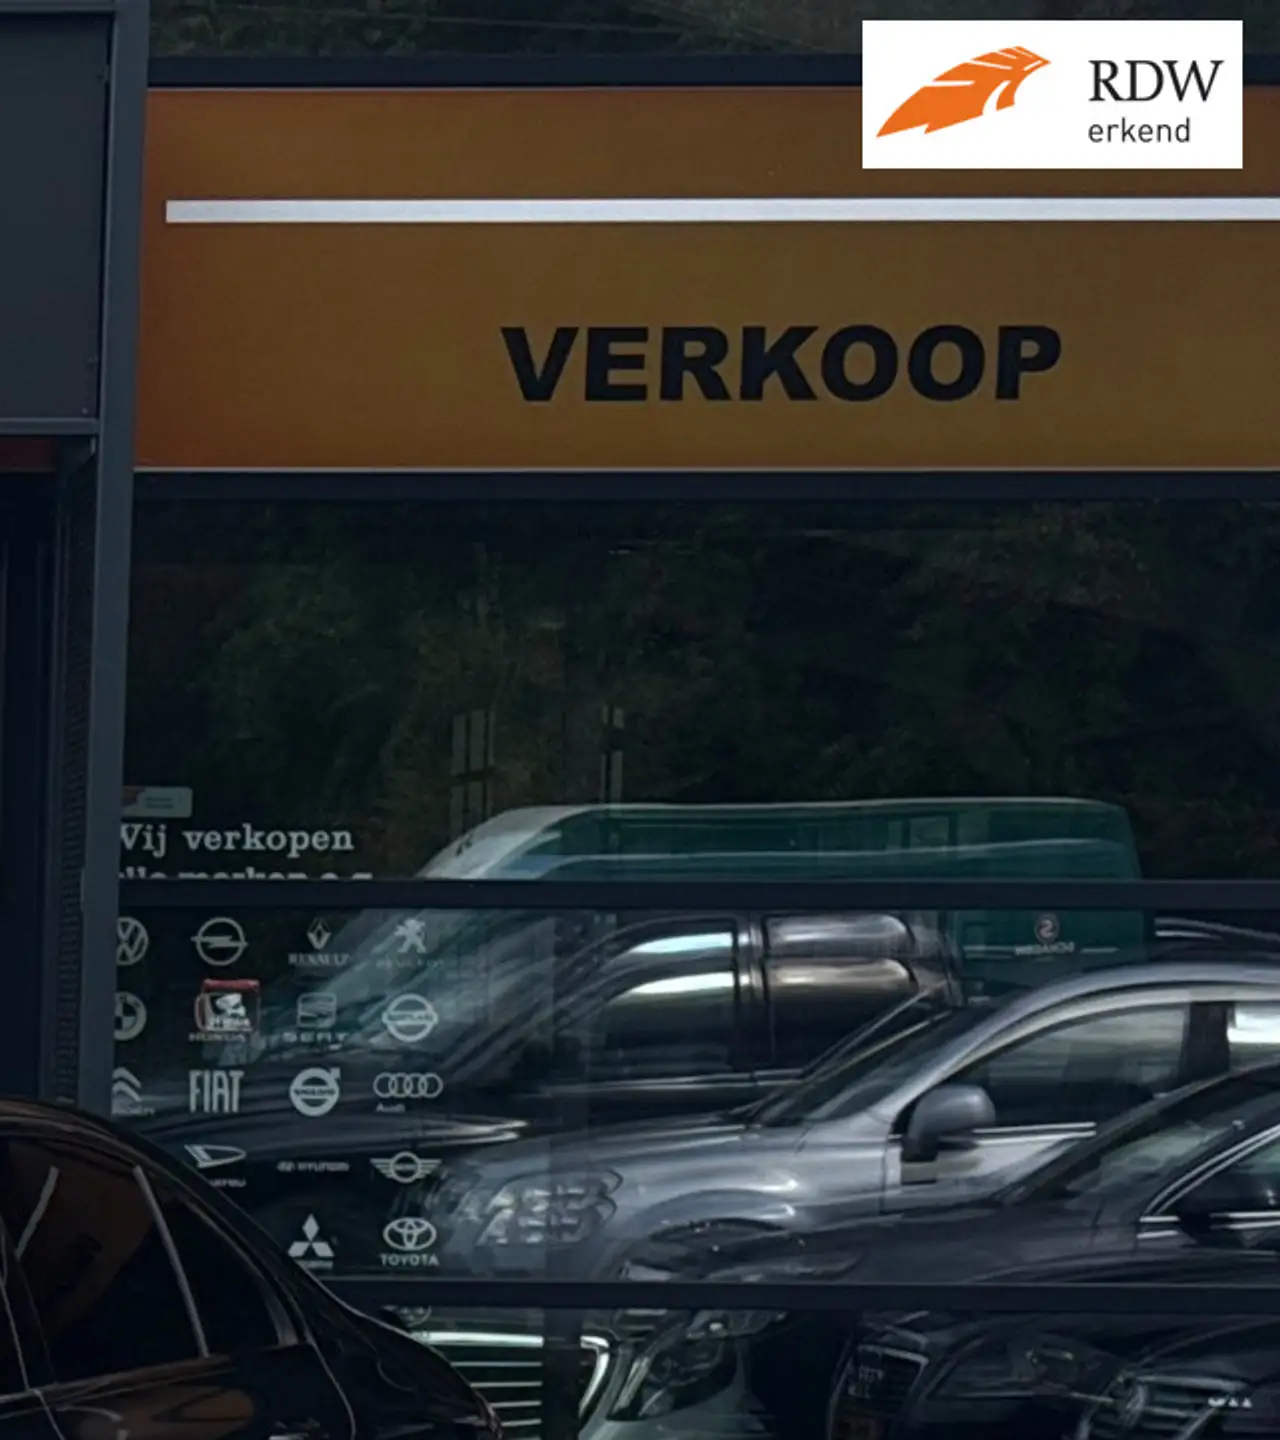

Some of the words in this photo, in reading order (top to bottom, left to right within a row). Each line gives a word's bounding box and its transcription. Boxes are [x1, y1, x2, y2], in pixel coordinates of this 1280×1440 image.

[500, 323, 1062, 402] VERKOOP
[182, 823, 355, 859] verkopen
[188, 1068, 245, 1114] FIAT
[379, 1252, 440, 1267] TOYOTA
